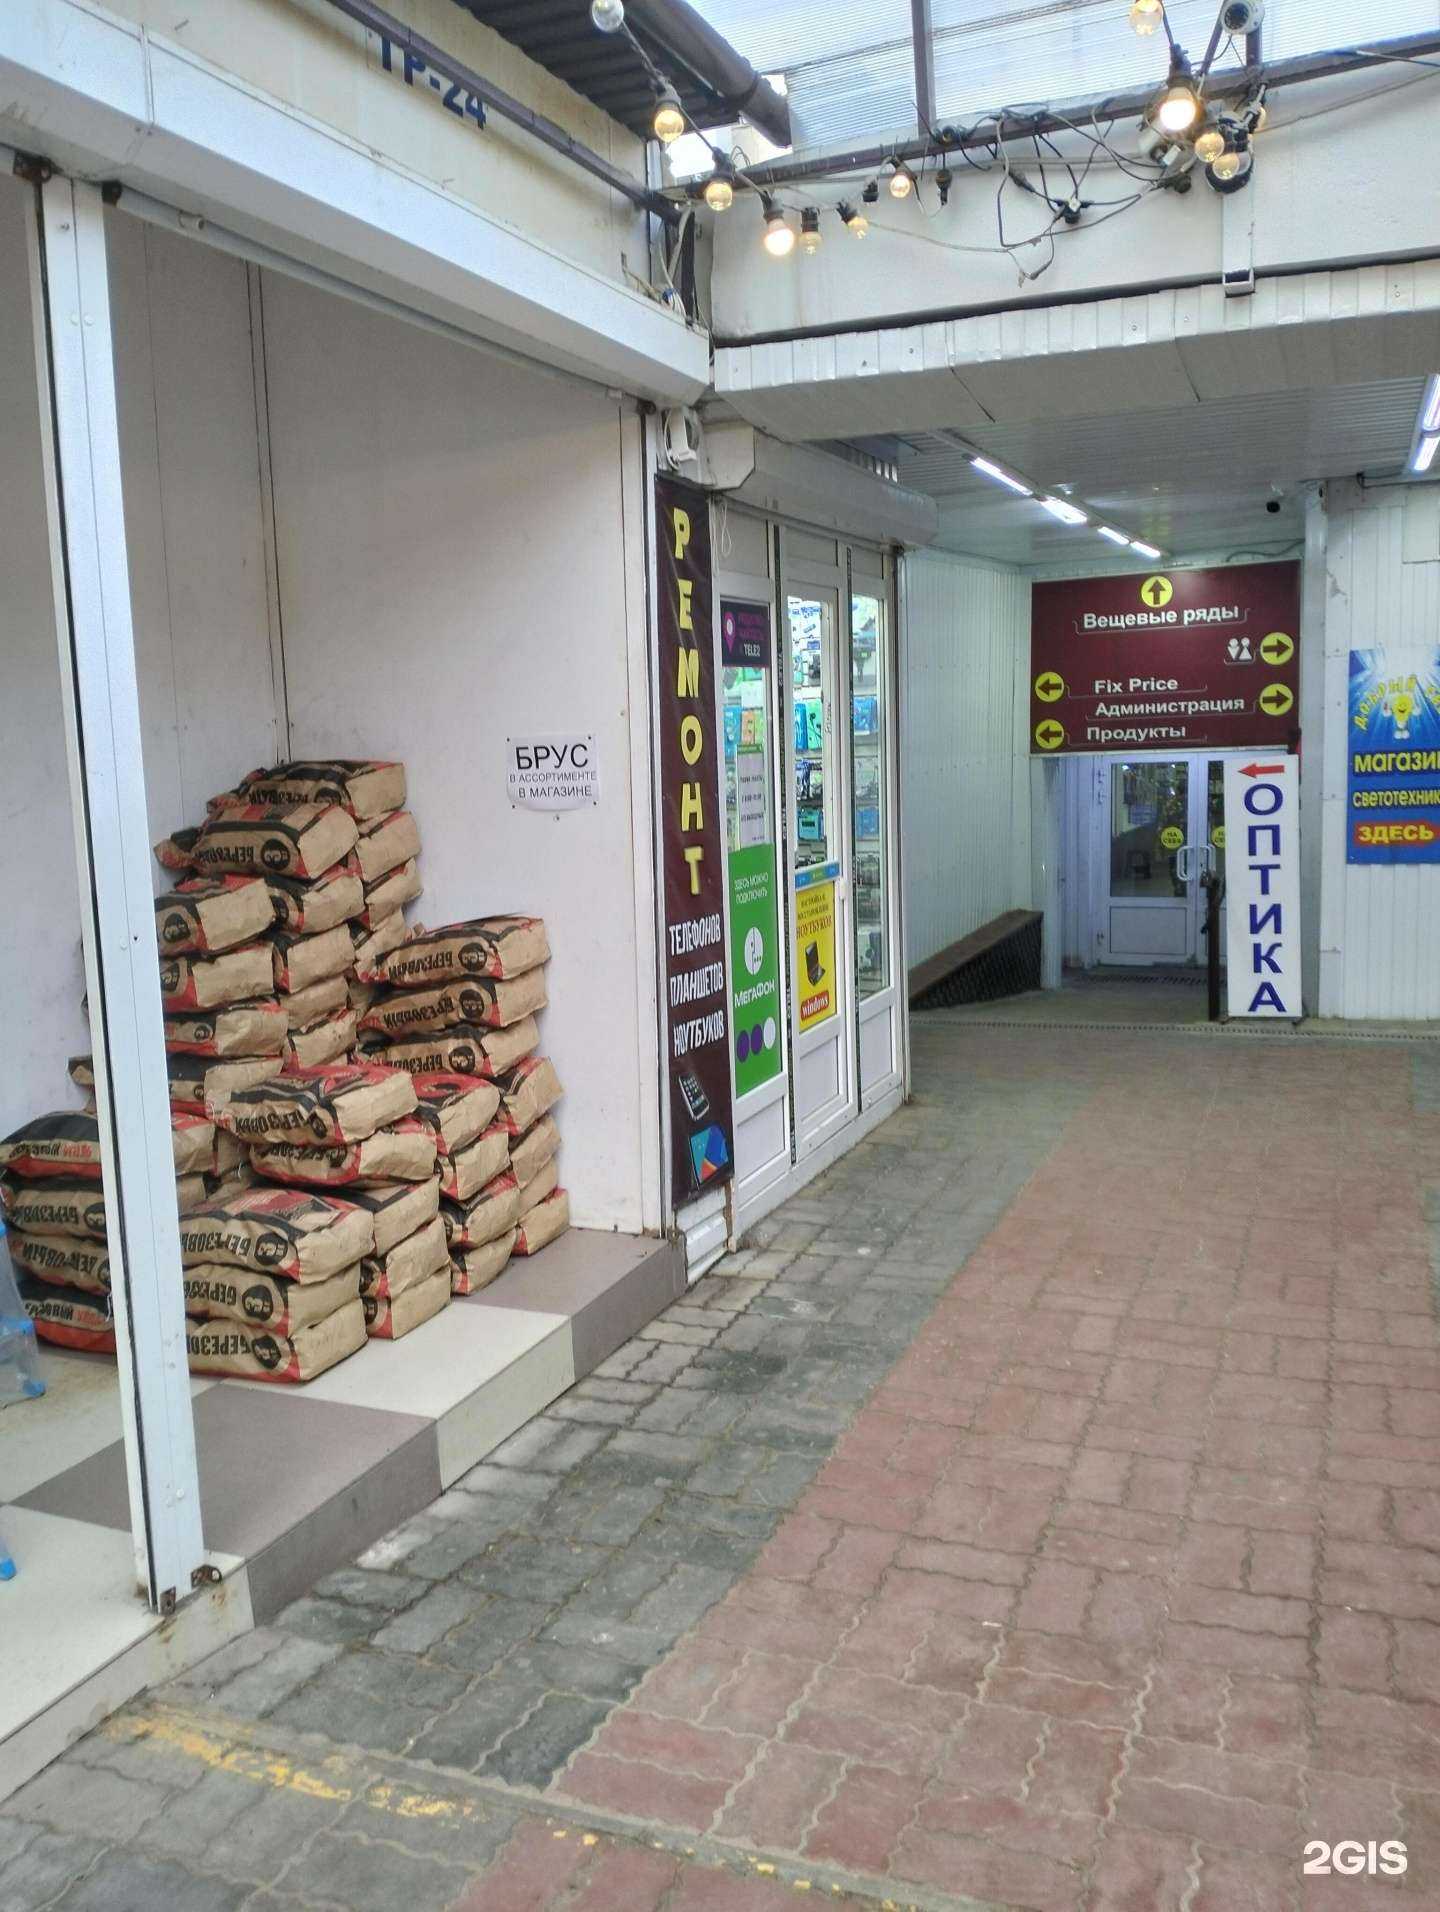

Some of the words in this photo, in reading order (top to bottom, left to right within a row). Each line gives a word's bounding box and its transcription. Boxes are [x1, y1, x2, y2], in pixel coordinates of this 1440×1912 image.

[1083, 610, 1178, 629] Вещевые
[1183, 605, 1240, 625] ряды
[1094, 680, 1123, 695] Fix
[1129, 677, 1179, 692] Price
[673, 507, 704, 895] РЕМОНТ
[1095, 698, 1245, 717] Администрация
[1087, 726, 1186, 743] Продукты
[515, 743, 588, 770] БРУС
[519, 771, 597, 783] АССОРТИМЕНТЕ
[519, 787, 526, 798] В
[530, 785, 593, 798] МАГАЗИНЕ
[1358, 824, 1434, 844] ЗДЕСЬ
[1243, 783, 1287, 1013] ОПТИКА
[669, 913, 721, 956] ТЕЛЕФОНОВ
[670, 961, 724, 1007] ПЛАНШЕТОВ
[734, 979, 775, 1009] МЕГАФОН
[673, 1009, 725, 1058] НОУТБУКОВ
